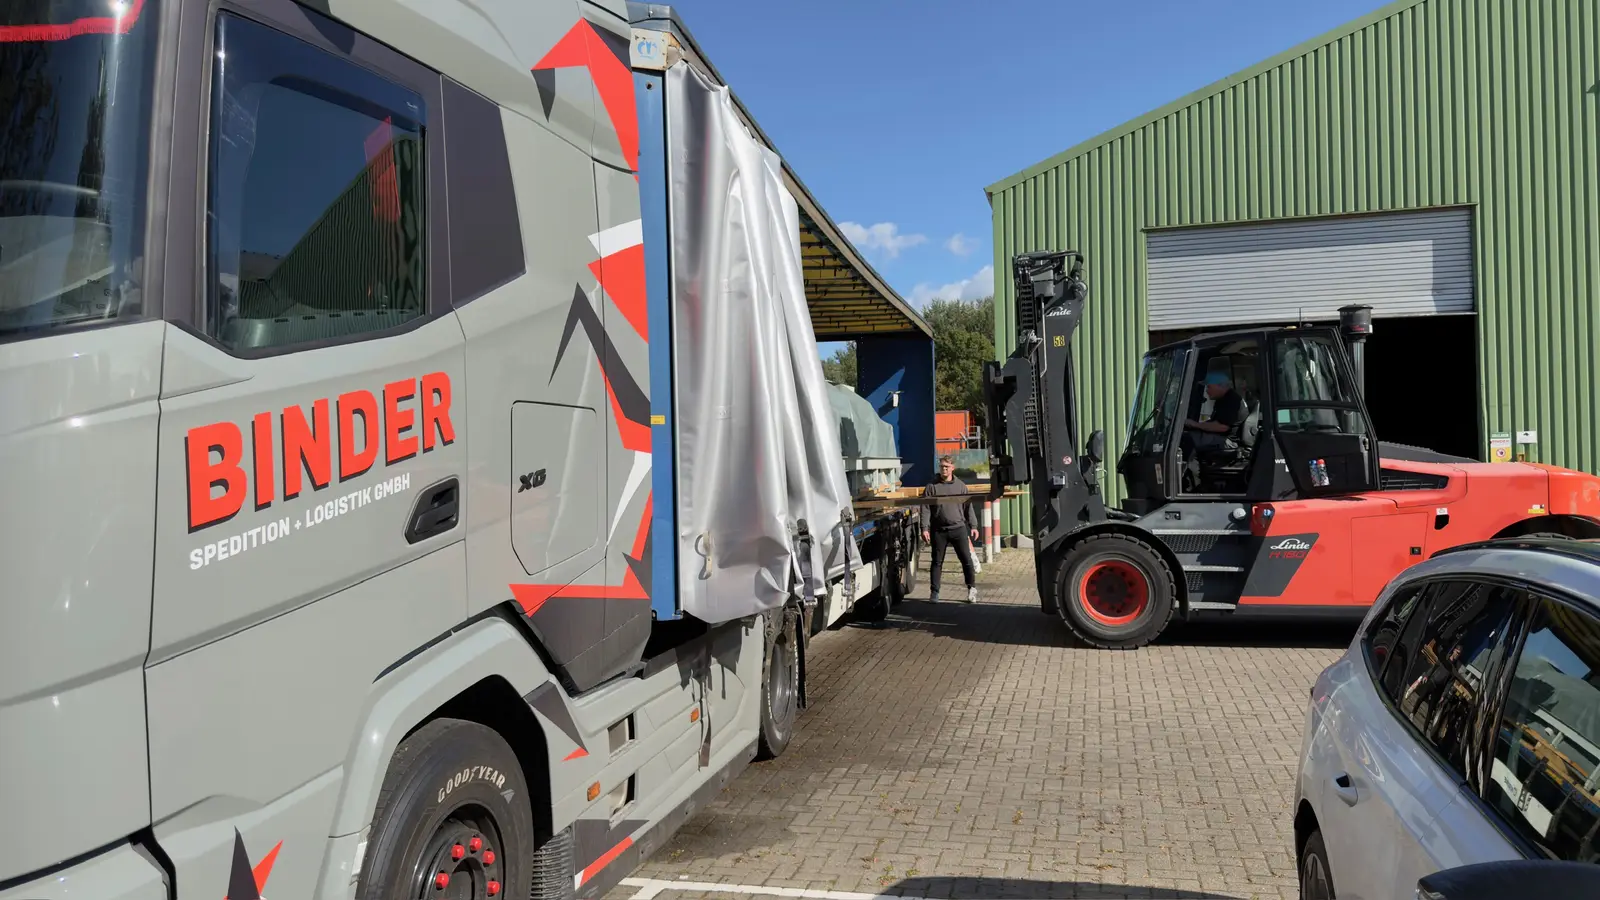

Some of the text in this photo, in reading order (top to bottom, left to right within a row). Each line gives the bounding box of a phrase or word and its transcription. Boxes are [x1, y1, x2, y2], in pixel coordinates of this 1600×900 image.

[1054, 336, 1065, 346] 58
[185, 371, 456, 533] BINDER
[518, 468, 547, 493] XG
[190, 472, 410, 570] SPEDITION + LOGISTIK GMBH
[1270, 538, 1310, 550] Linde
[437, 765, 506, 803] GOODYEAR
